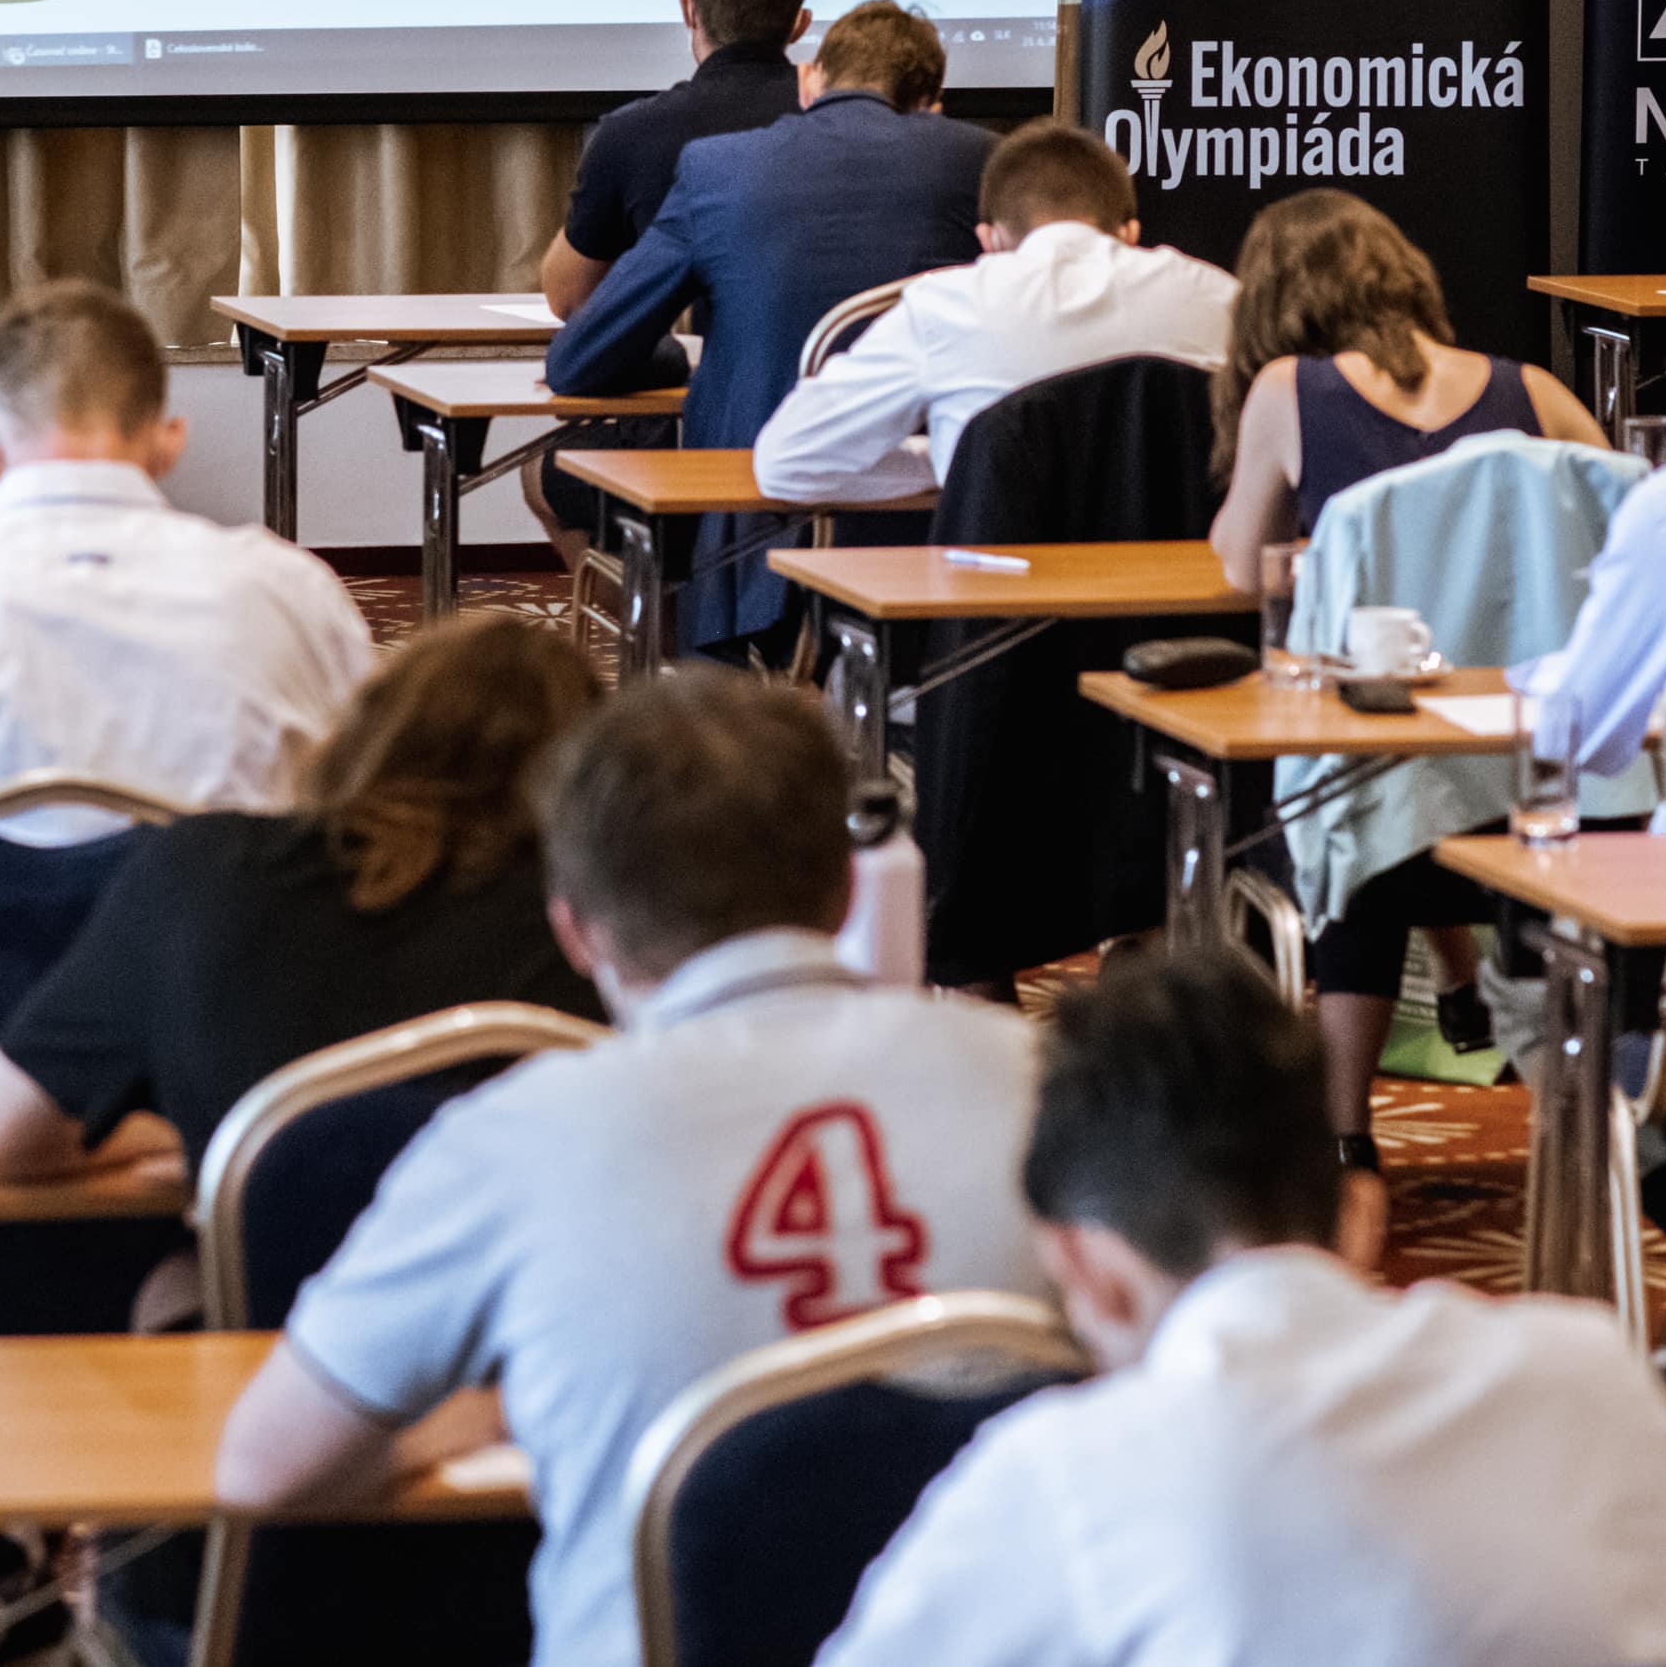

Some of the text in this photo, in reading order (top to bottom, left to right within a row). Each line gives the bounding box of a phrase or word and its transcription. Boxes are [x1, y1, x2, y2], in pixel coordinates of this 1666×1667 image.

[1190, 40, 1524, 108] Ekonomická
[1104, 109, 1405, 191] Olympiáda
[724, 1097, 931, 1333] 4
